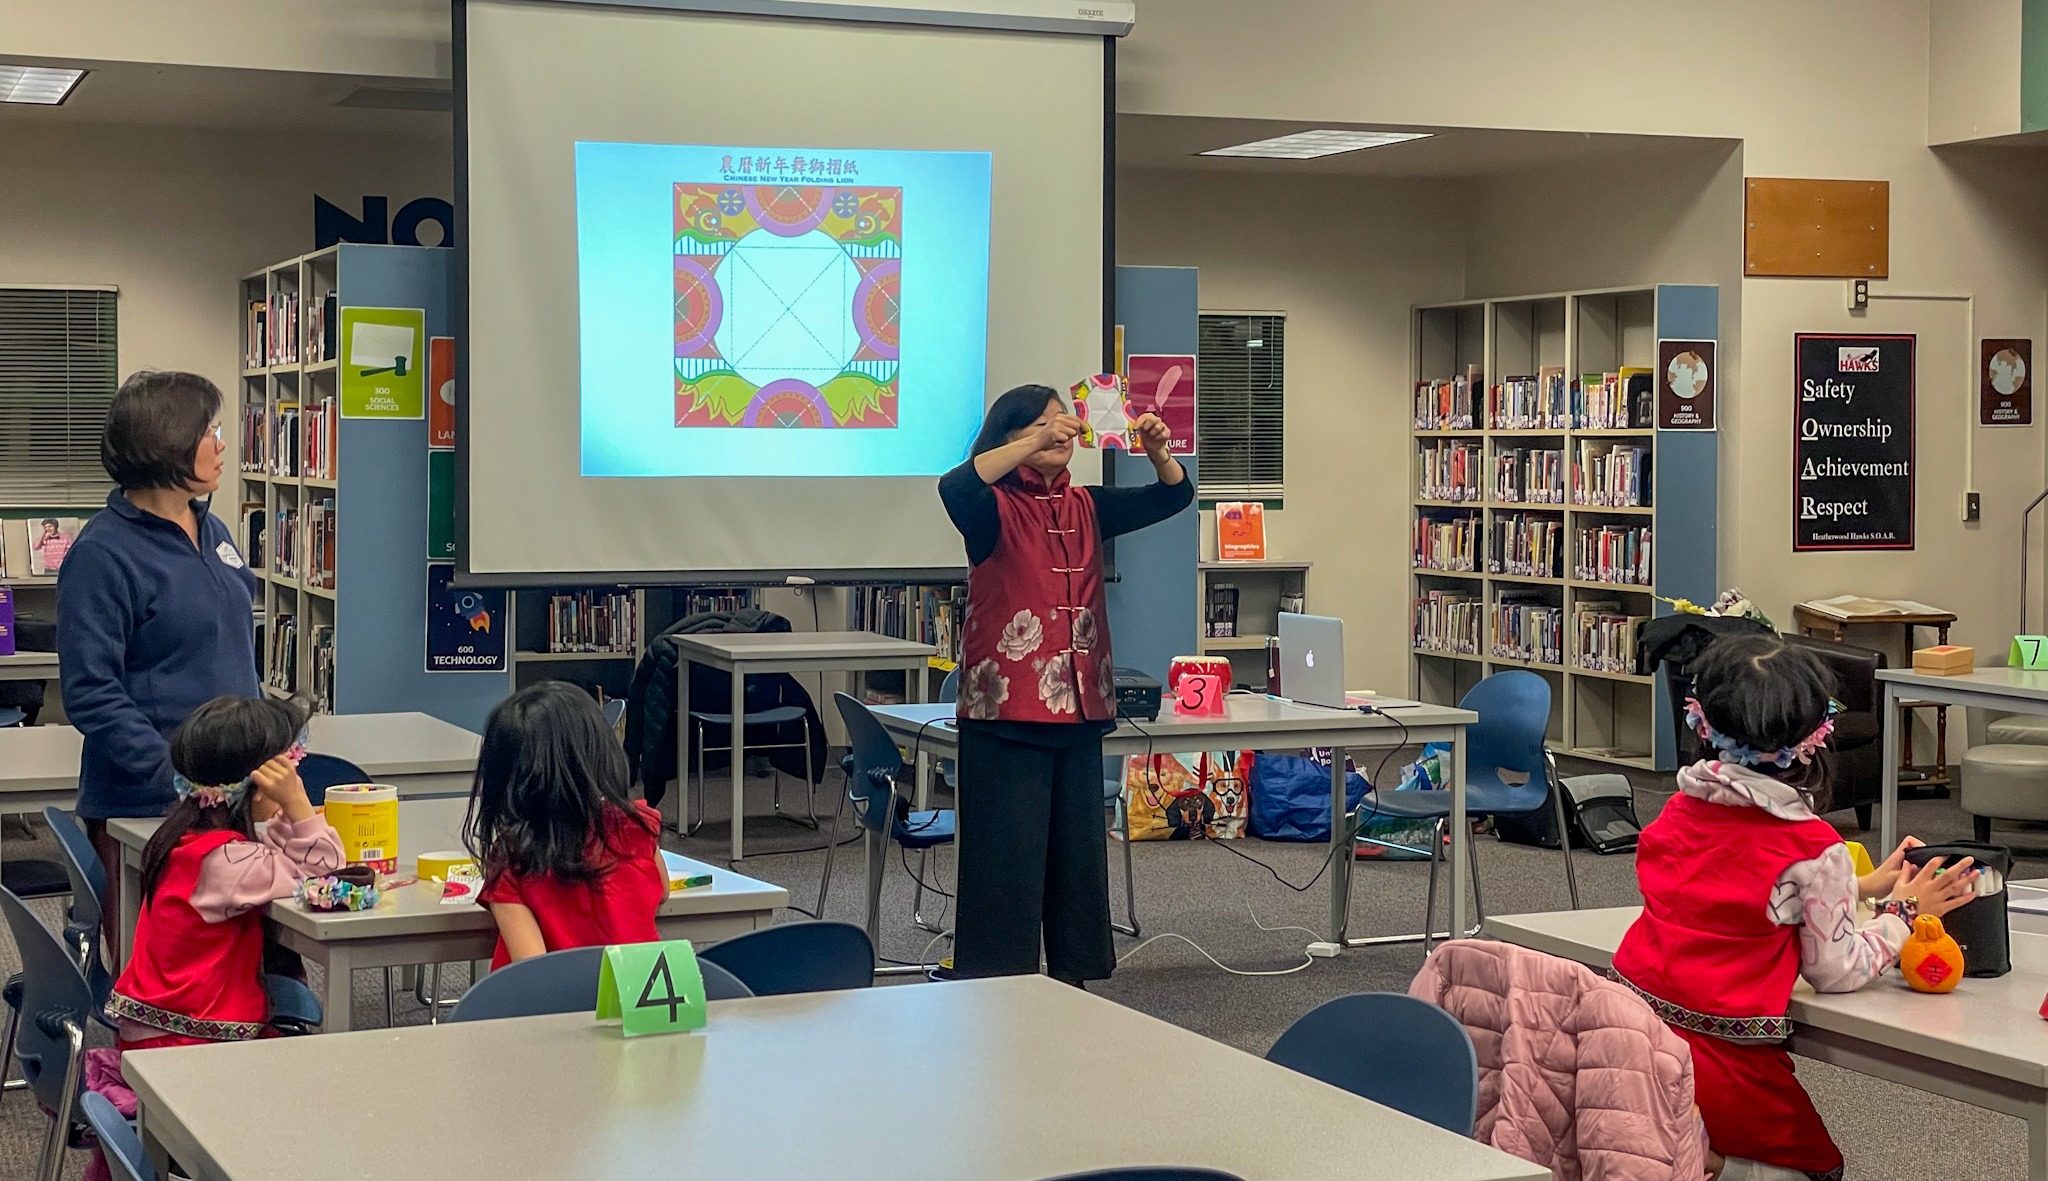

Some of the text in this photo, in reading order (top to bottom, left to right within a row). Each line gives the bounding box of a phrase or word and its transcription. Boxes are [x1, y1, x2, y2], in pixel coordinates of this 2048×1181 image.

[779, 175, 799, 183] YEAR
[1840, 360, 1878, 371] HAWKS
[374, 387, 391, 396] 300
[1803, 378, 1856, 404] Safety
[365, 403, 400, 411] SCIENCES
[369, 397, 396, 405] SOCIAL
[1801, 418, 1892, 443] Ownership
[1801, 457, 1910, 479] Achievement
[1801, 496, 1869, 521] Respect
[1812, 532, 1850, 540] Heatherwood
[1850, 532, 1869, 540] Hawks
[434, 655, 498, 665] TECHNOLOGY
[2023, 639, 2041, 666] 7
[1181, 677, 1207, 710] 3
[635, 950, 685, 1023] 4
